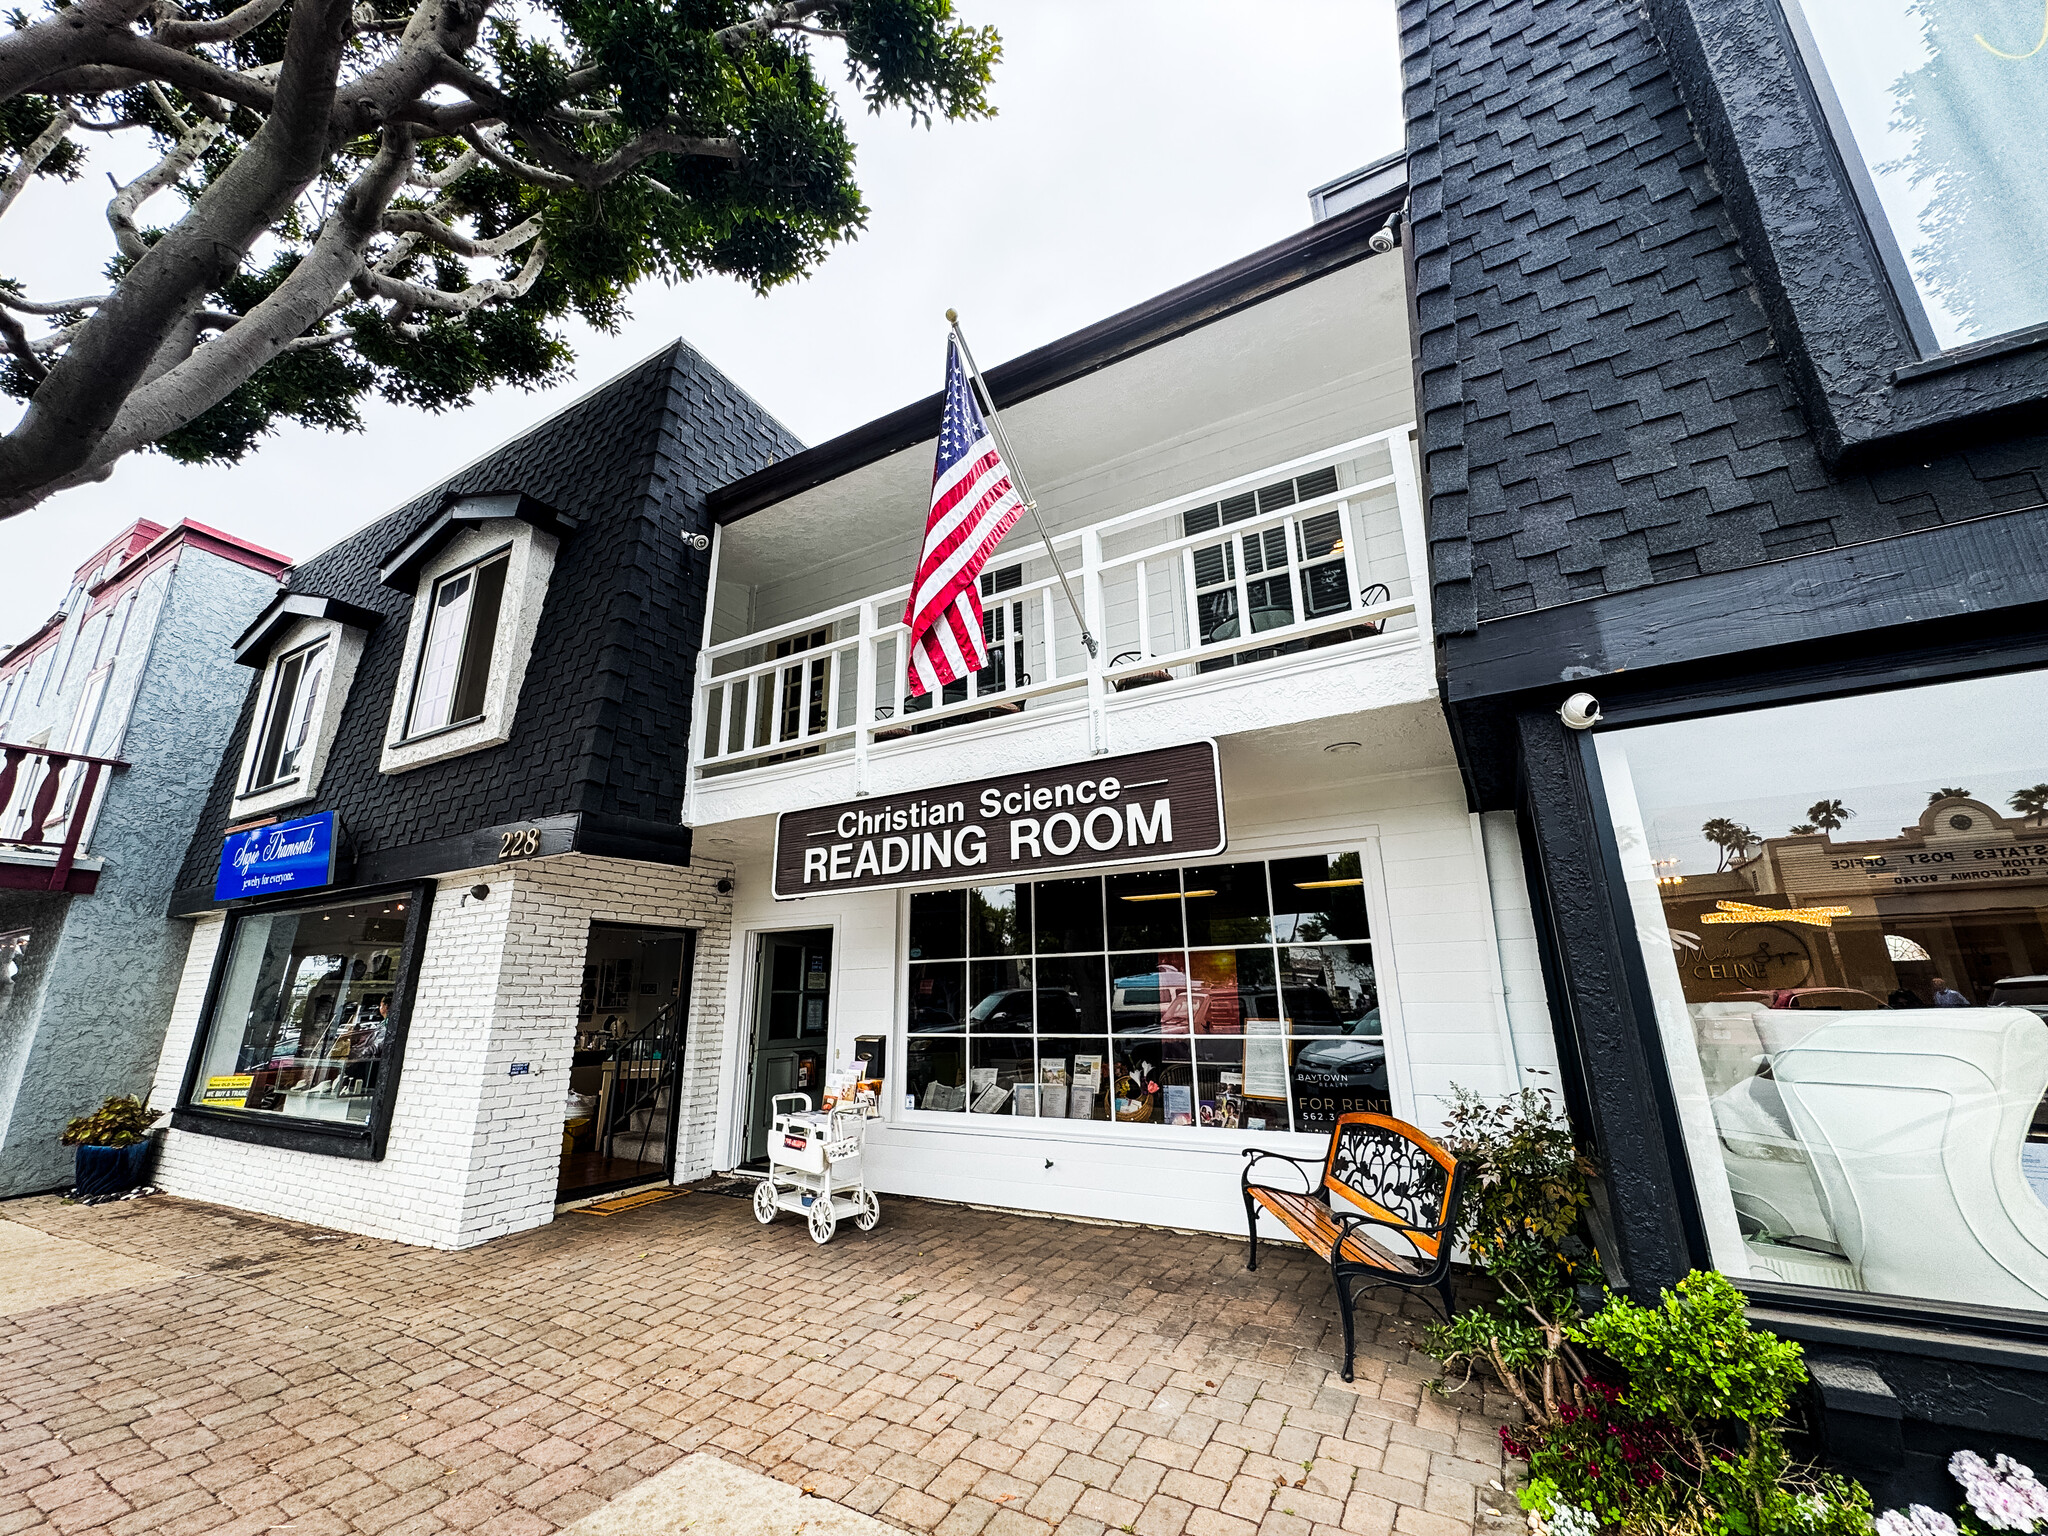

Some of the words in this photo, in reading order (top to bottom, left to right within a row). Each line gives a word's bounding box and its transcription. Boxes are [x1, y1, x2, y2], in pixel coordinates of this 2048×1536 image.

[837, 798, 965, 840] Christian
[979, 776, 1121, 819] Science
[232, 837, 260, 876] Suzie
[262, 827, 316, 861] Diamonds
[498, 828, 541, 858] 228
[803, 825, 987, 885] READING
[1010, 799, 1173, 861] ROOM
[241, 876, 261, 891] jewelry
[262, 874, 270, 886] for
[1693, 964, 1767, 979] CELINE
[1297, 1074, 1348, 1082] BAYTOWN
[1299, 1097, 1335, 1110] FOR
[1342, 1098, 1389, 1111] RENT
